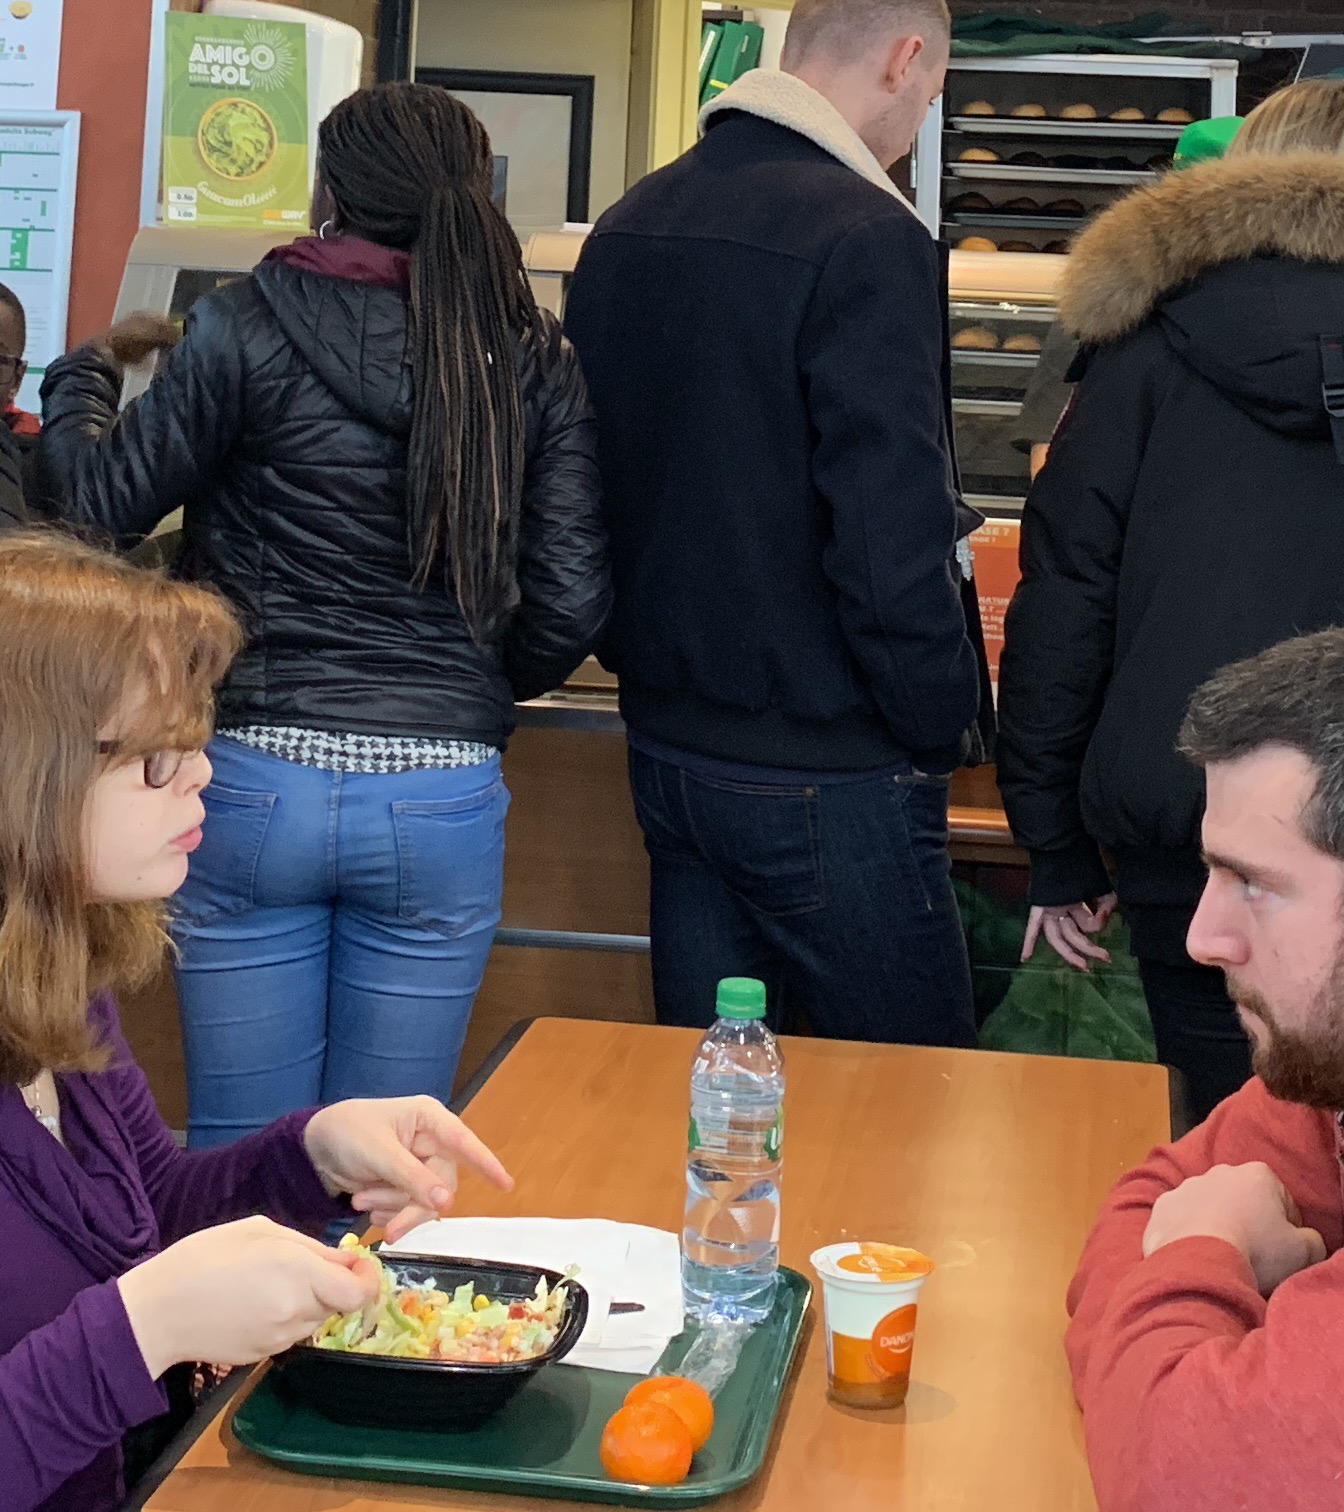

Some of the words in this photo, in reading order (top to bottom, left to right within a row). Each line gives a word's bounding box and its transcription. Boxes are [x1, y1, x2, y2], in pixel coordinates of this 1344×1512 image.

[188, 43, 275, 71] AMIGO
[188, 62, 210, 75] DEL
[210, 65, 251, 86] SOL
